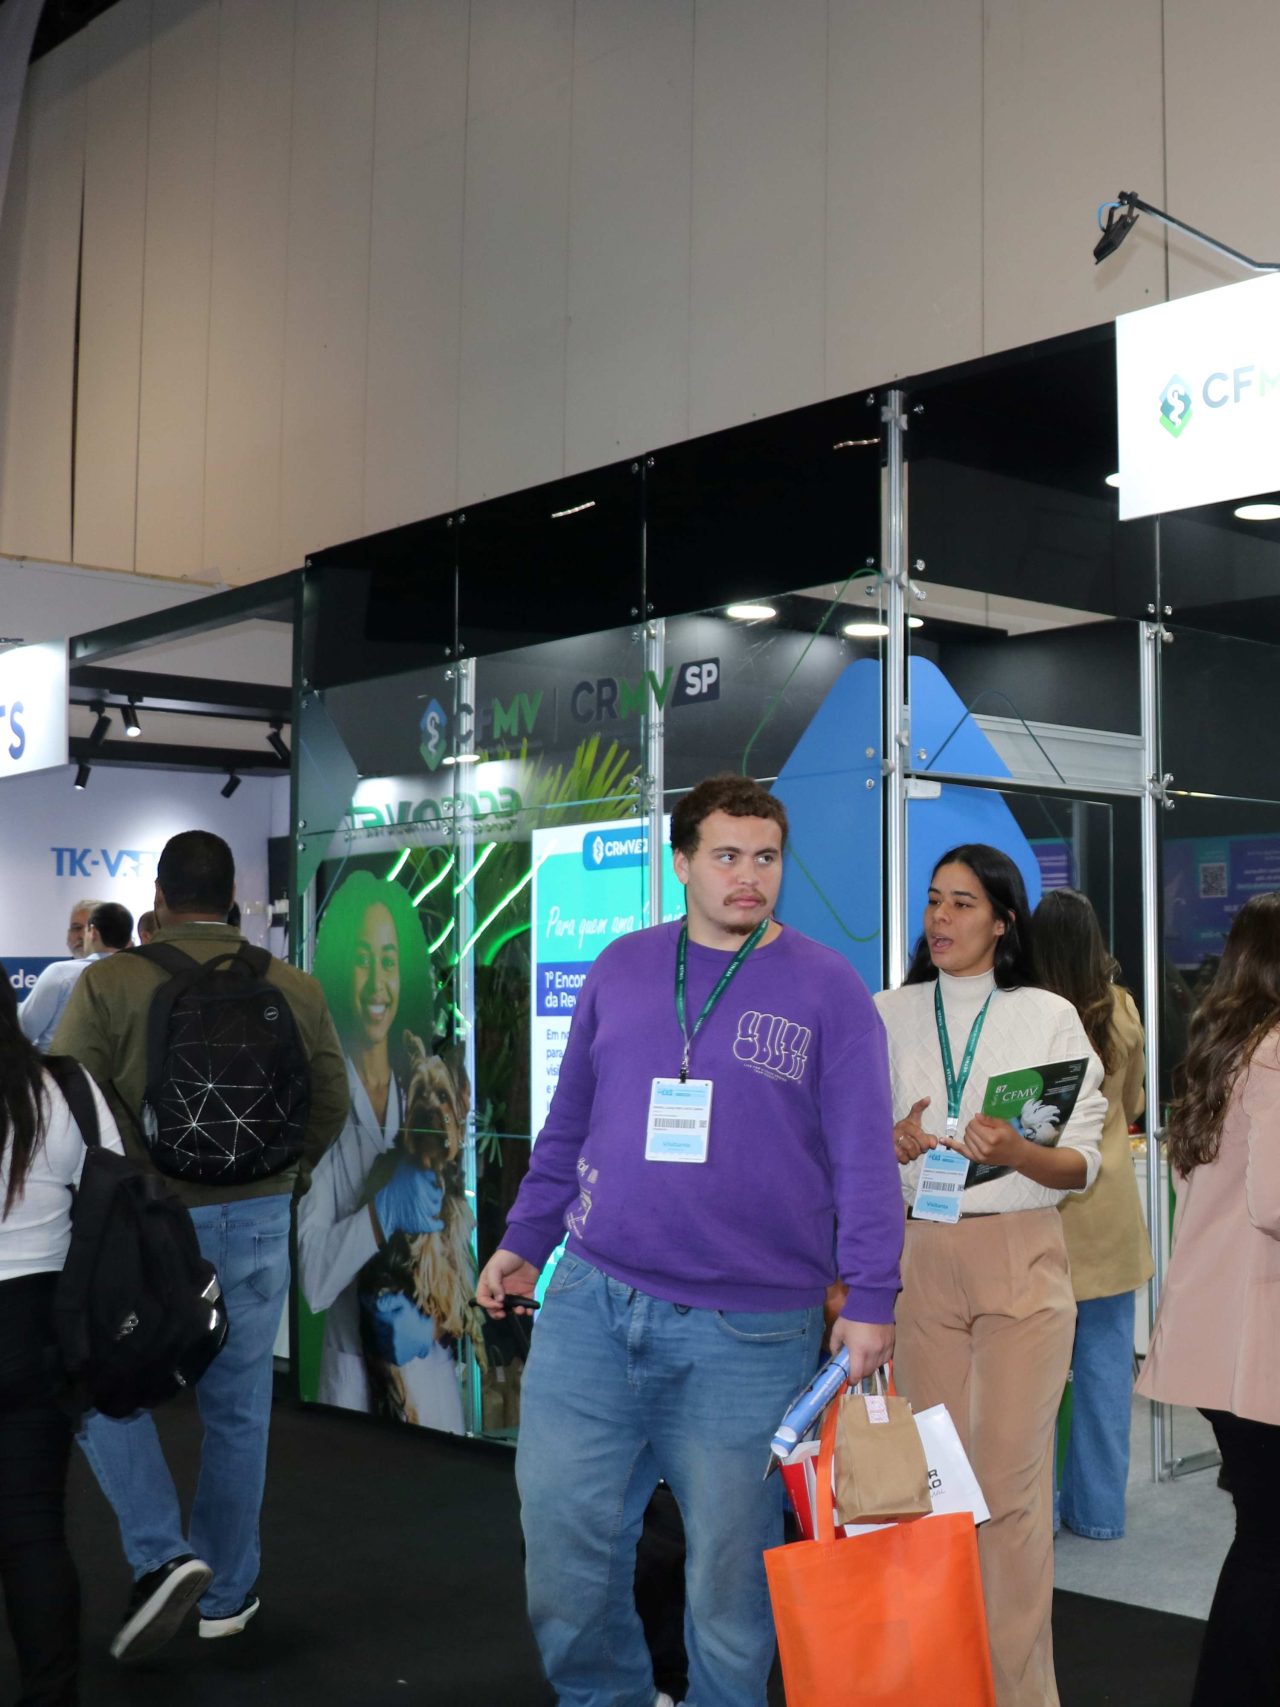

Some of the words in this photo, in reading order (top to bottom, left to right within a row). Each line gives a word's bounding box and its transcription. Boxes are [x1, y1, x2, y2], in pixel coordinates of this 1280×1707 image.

[571, 666, 674, 724] CRMV
[685, 662, 719, 696] SP
[546, 905, 575, 939] Para
[578, 917, 607, 950] quem
[544, 991, 559, 1008] da
[1002, 1087, 1038, 1102] CFMV
